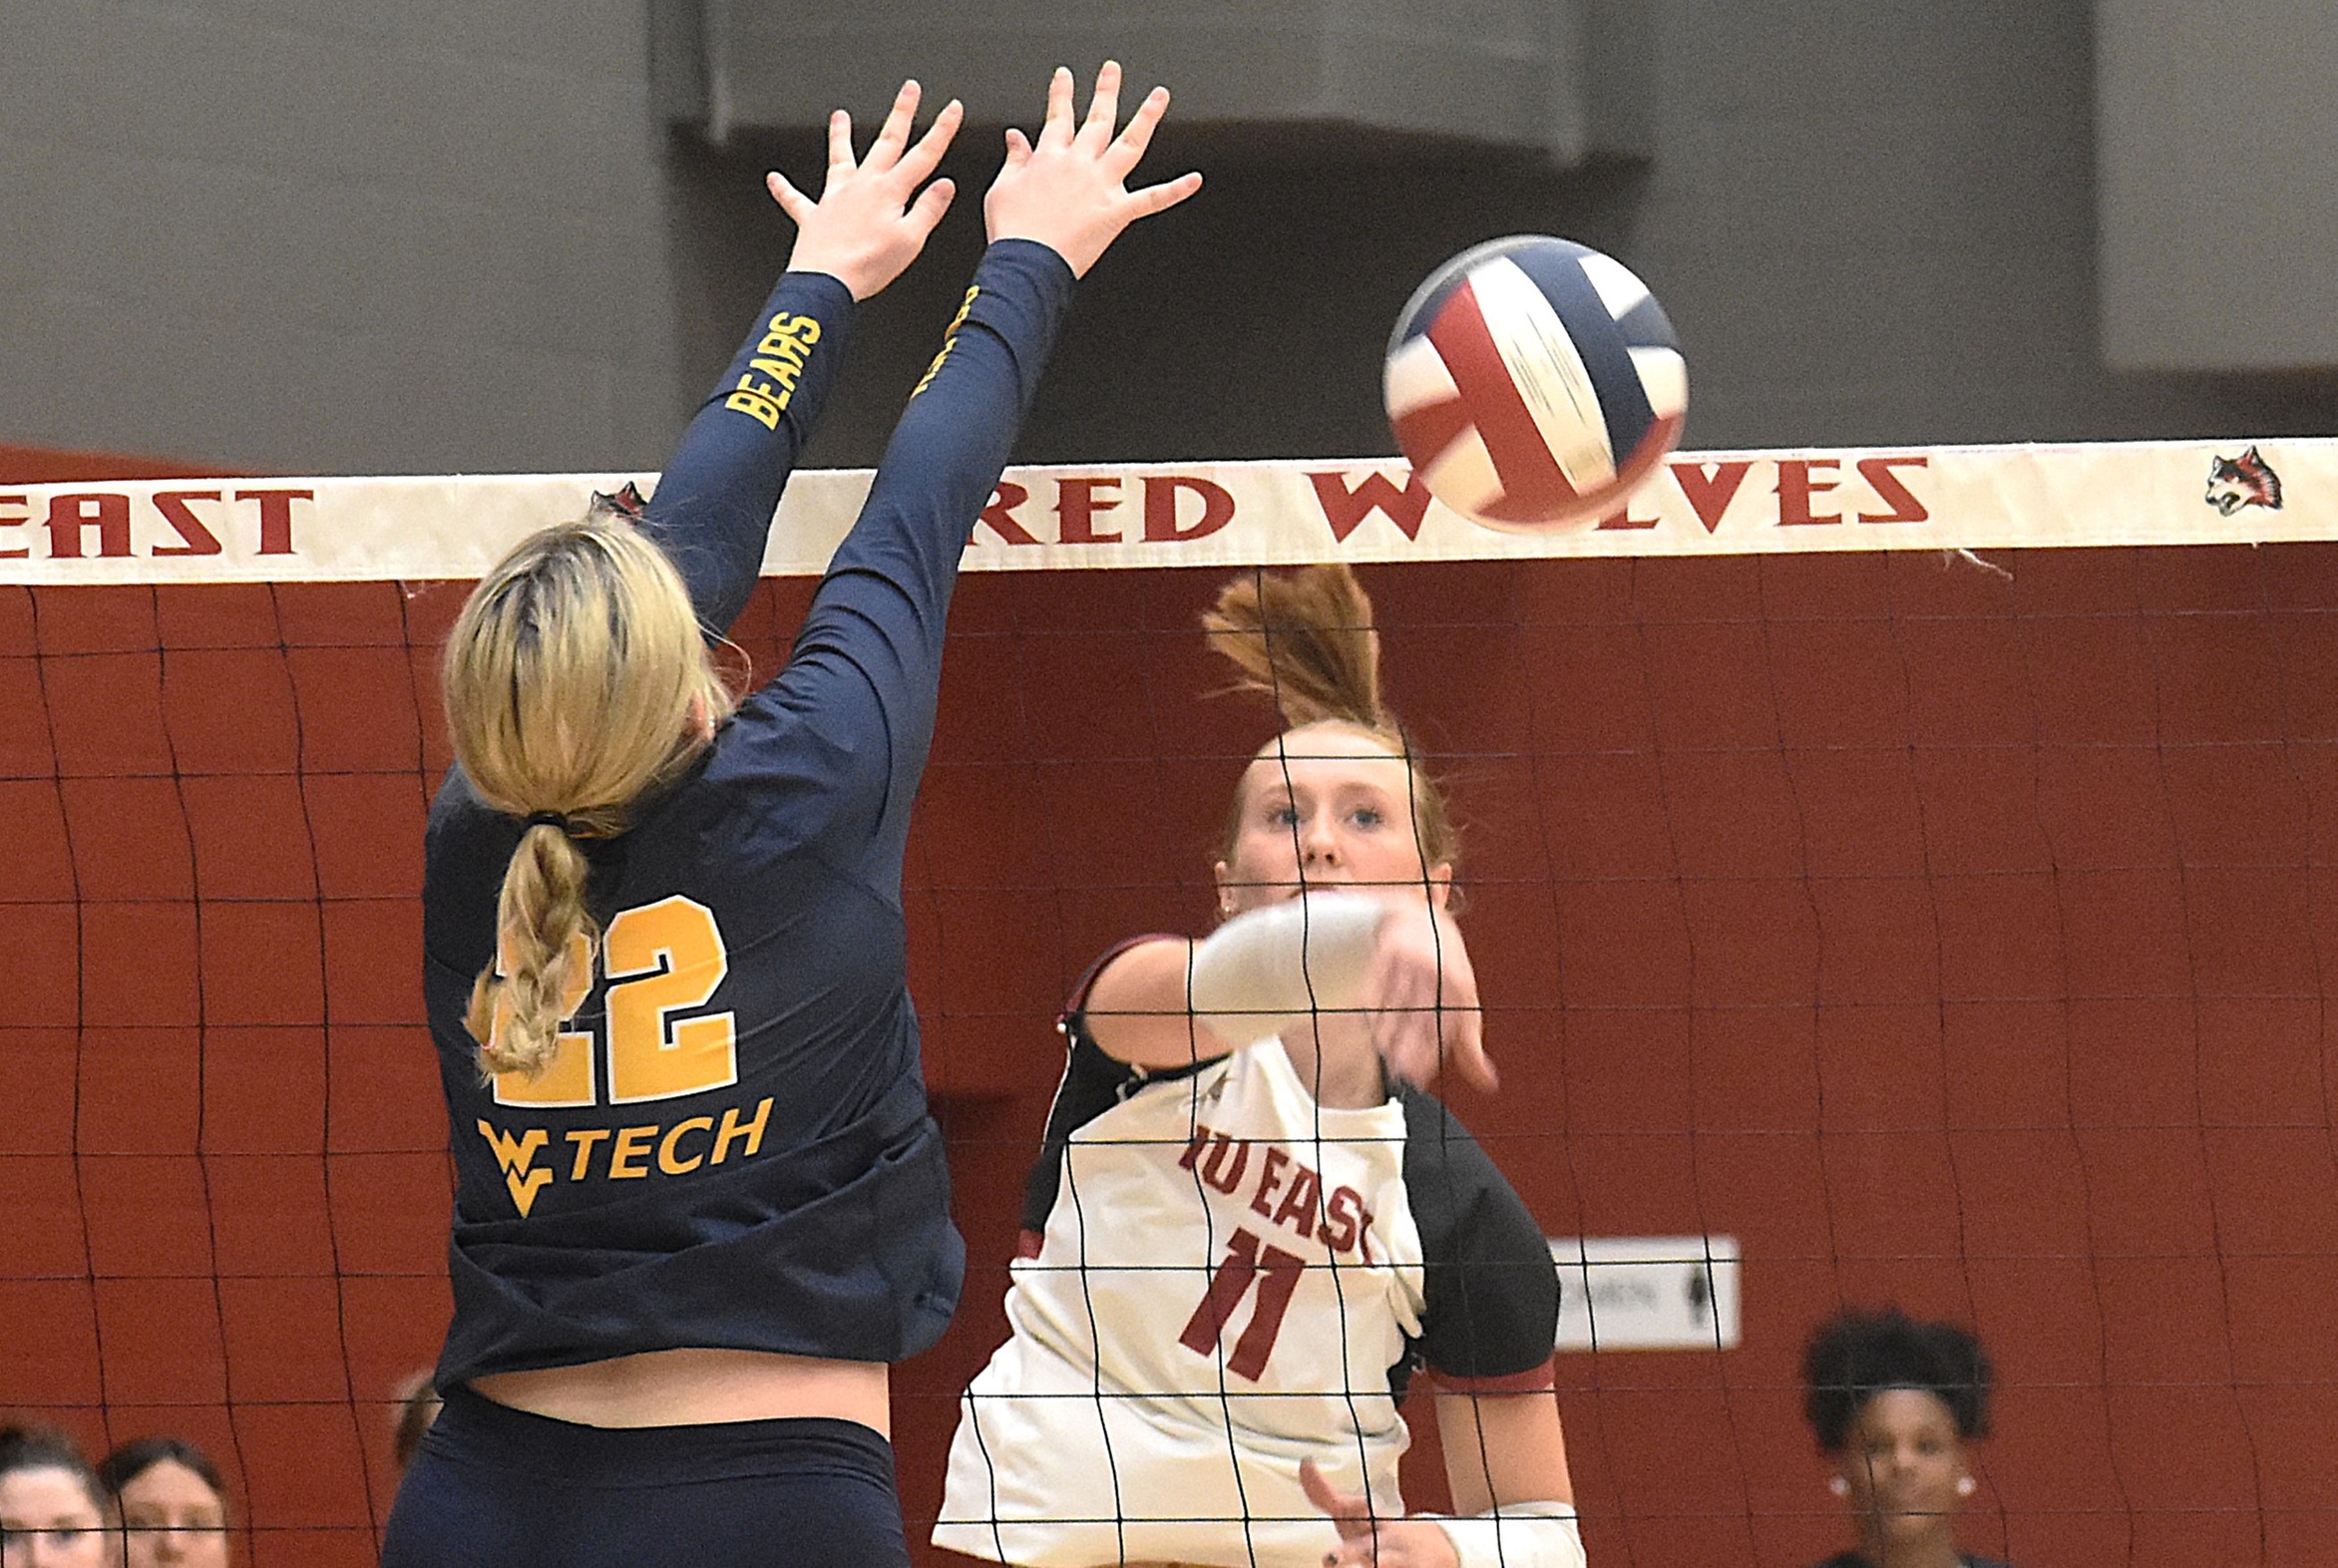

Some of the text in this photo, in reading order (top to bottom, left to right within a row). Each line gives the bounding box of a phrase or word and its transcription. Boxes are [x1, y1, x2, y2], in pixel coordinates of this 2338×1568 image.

[724, 311, 823, 431] BEARS
[966, 456, 1930, 547] RED WVES
[493, 894, 738, 1108] 22
[565, 1097, 774, 1181] TECH
